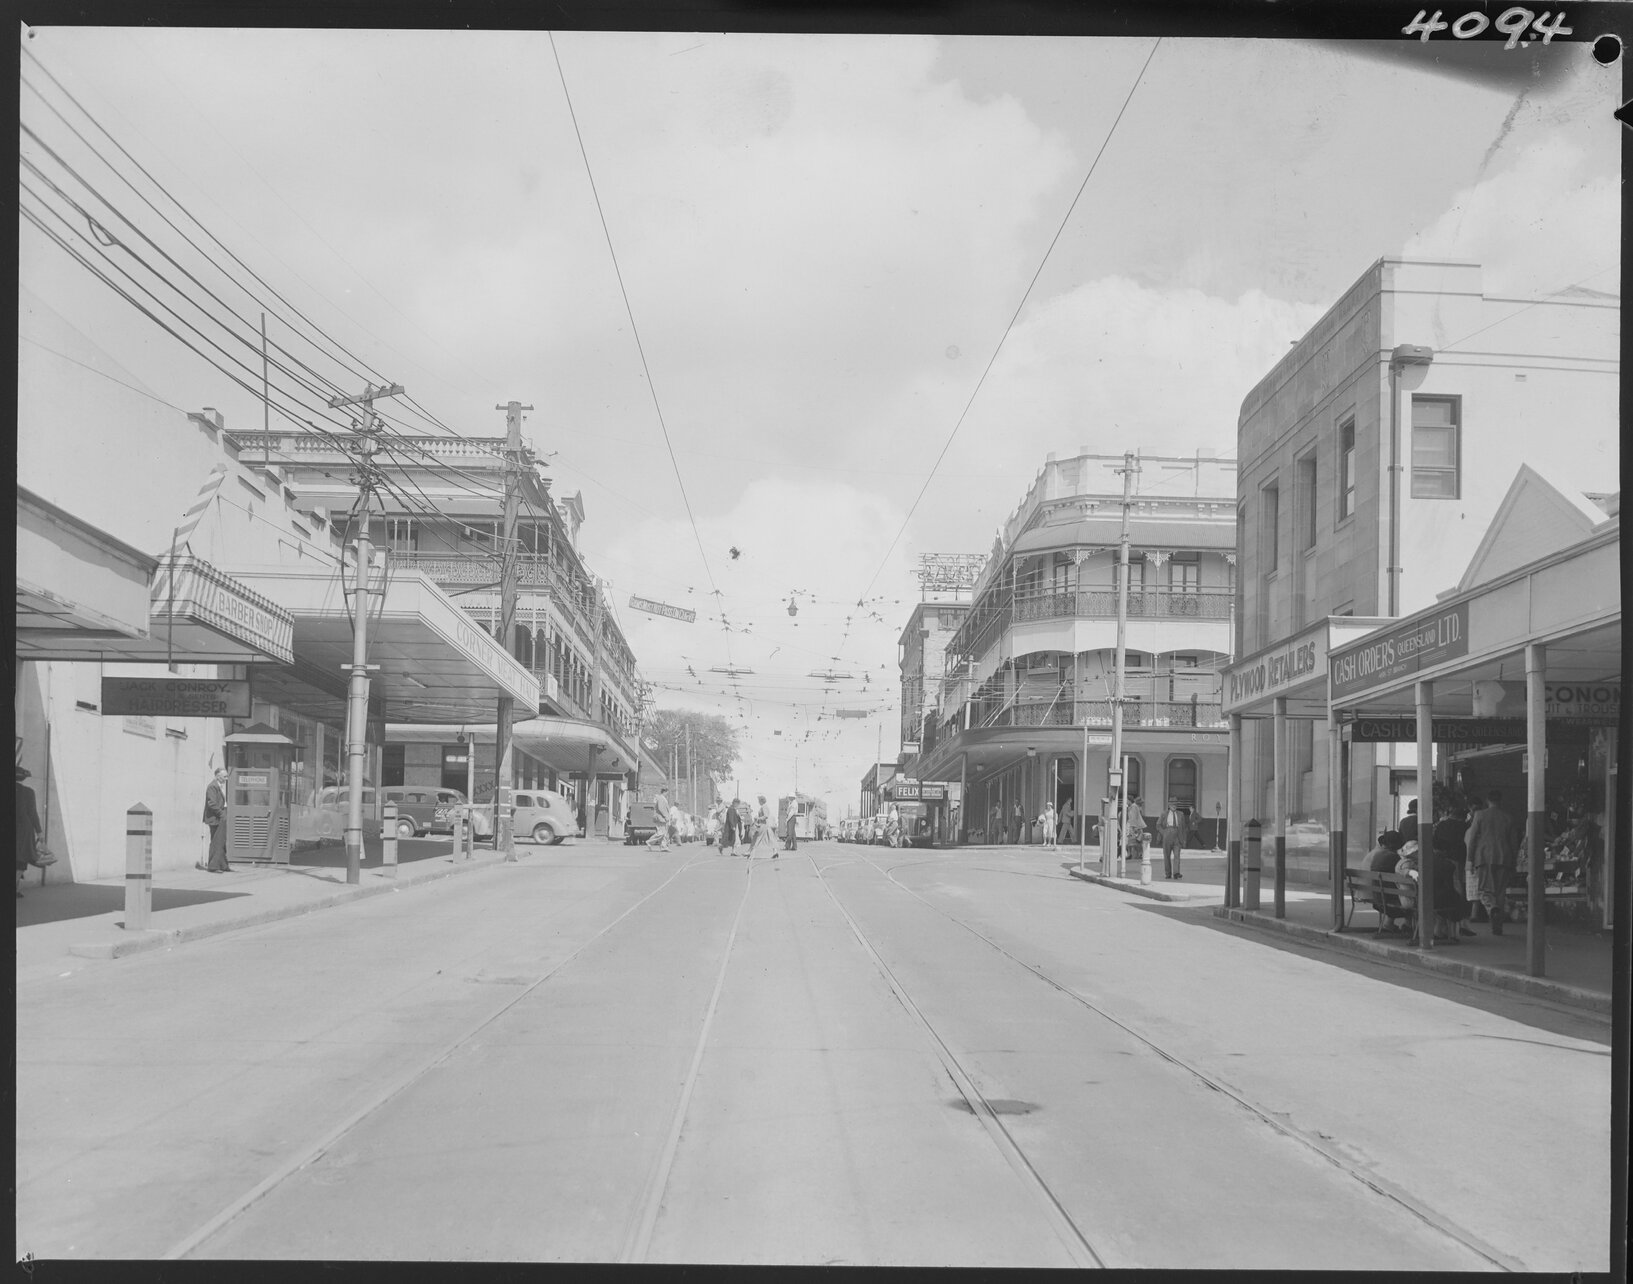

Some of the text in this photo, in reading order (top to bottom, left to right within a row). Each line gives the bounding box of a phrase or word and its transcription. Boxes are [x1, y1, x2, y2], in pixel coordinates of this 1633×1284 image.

[218, 591, 273, 635] BARBER SHOP
[661, 606, 673, 616] PASS
[673, 608, 680, 618] ON
[456, 620, 492, 667] CORNER
[1334, 613, 1462, 685] CASH ORDERS QUEENSLAND LTD.
[1230, 641, 1315, 704] PLYWOOD RETAILERS
[121, 682, 157, 692] JACK
[129, 698, 228, 714] HAIRDRESSER
[1360, 721, 1402, 739] CASH
[898, 787, 920, 796] FELIX
